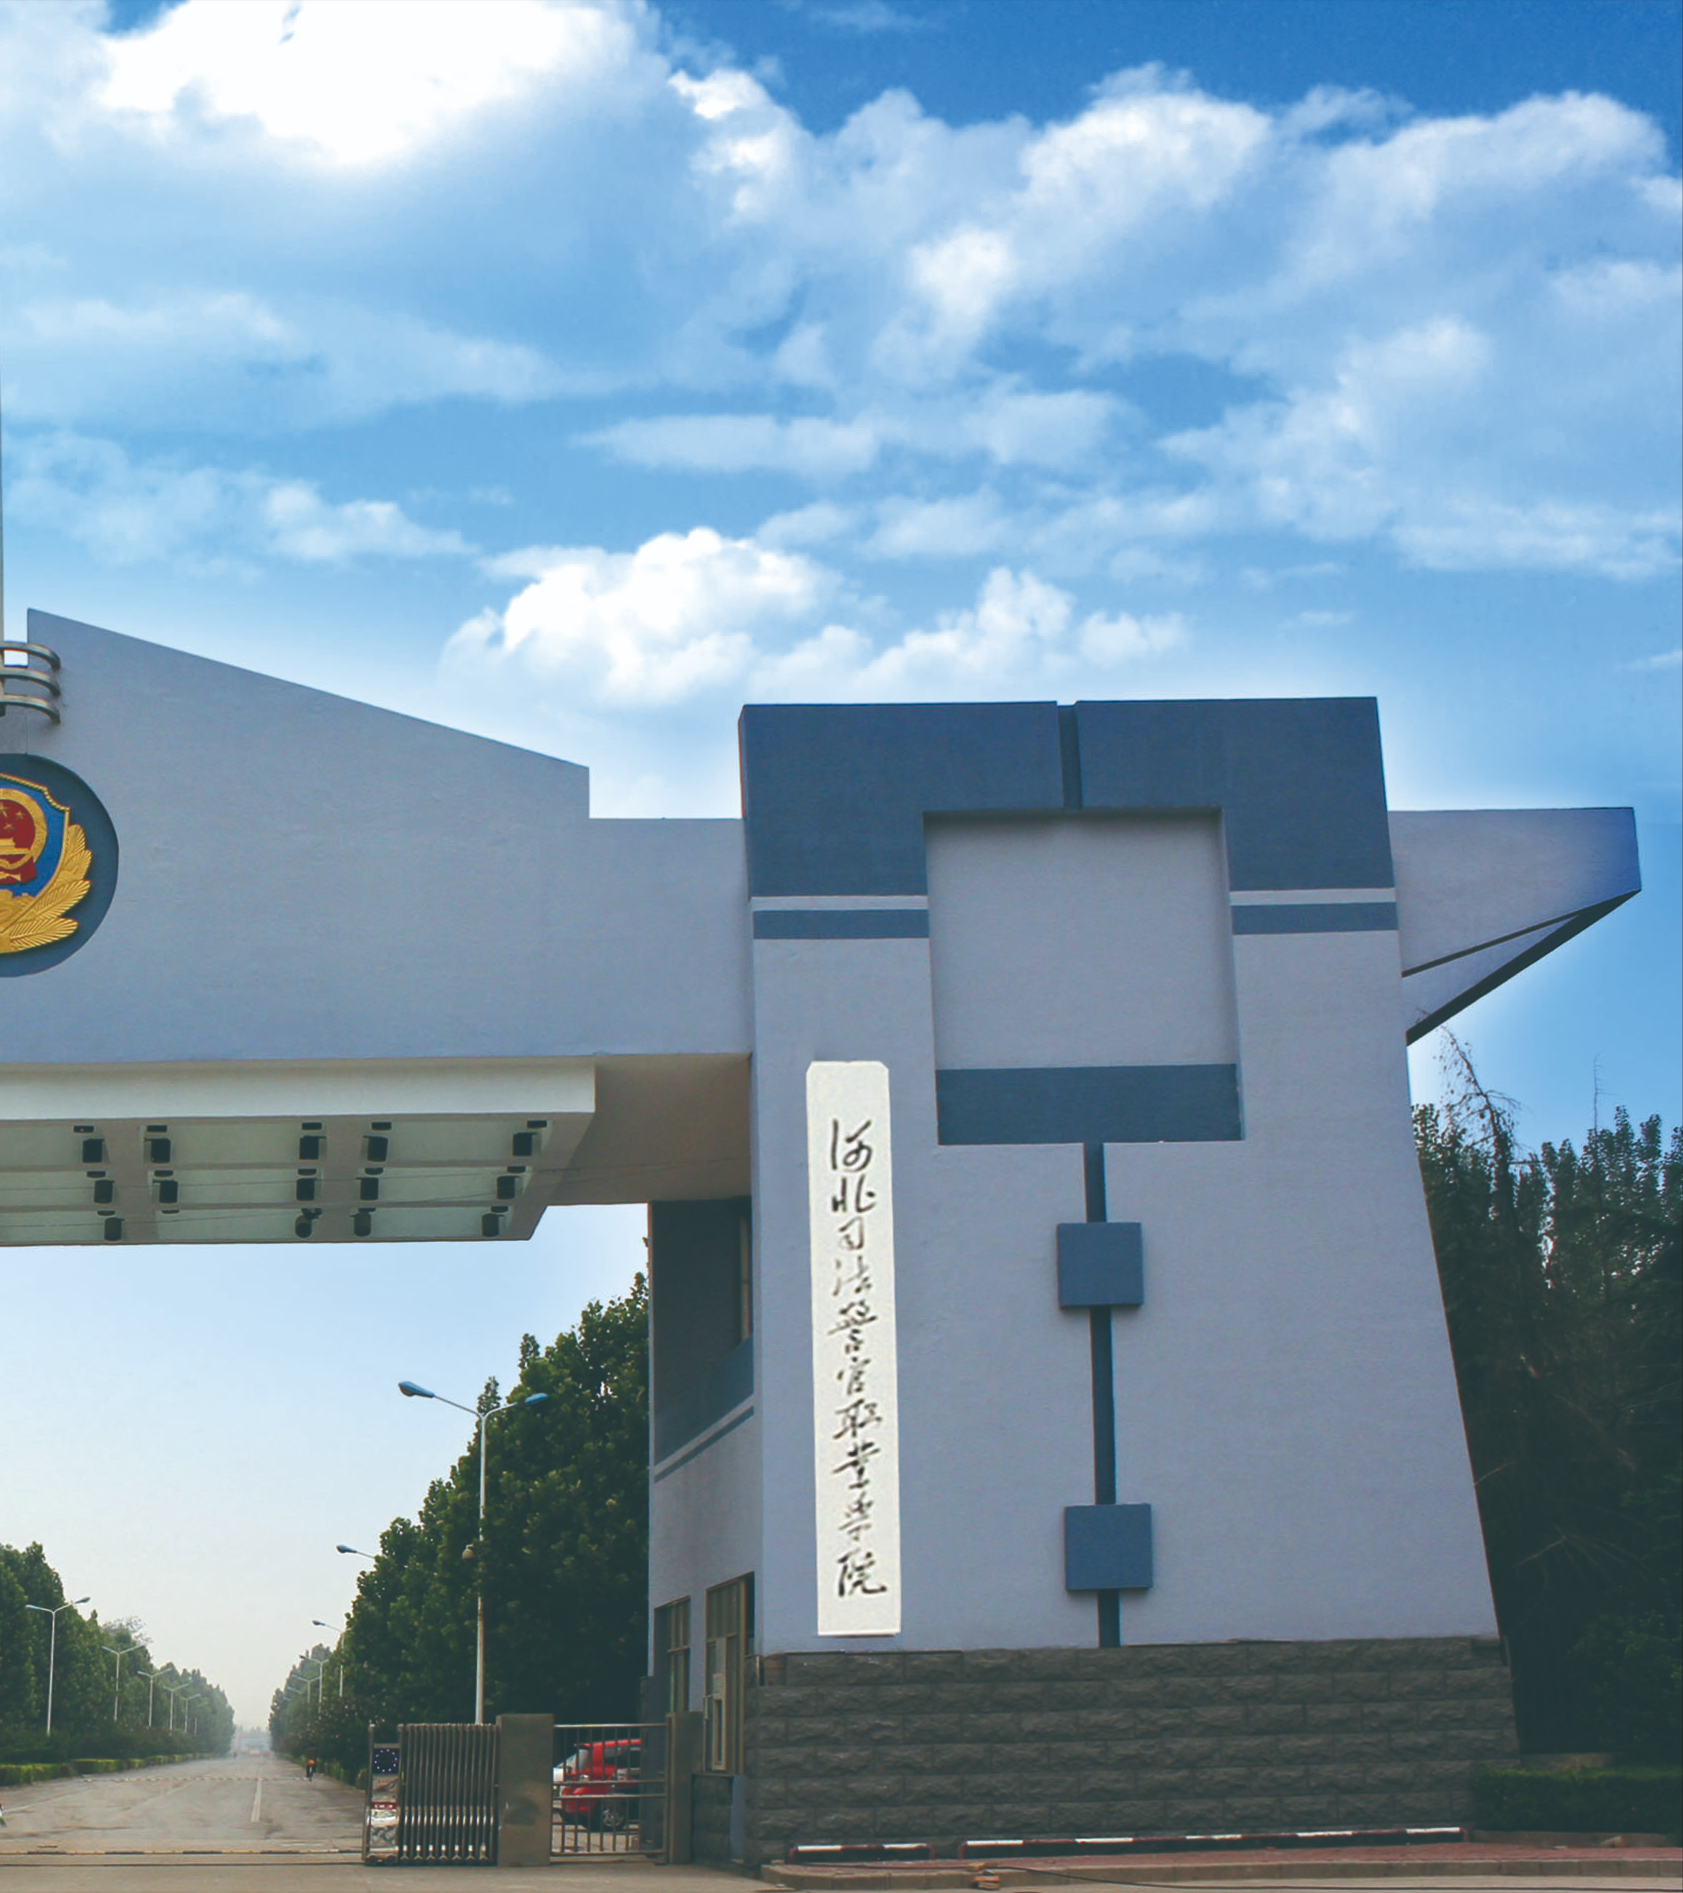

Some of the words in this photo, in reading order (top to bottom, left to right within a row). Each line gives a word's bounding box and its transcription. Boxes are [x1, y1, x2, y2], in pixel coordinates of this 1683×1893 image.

[827, 1118, 887, 1598] 河北司法警官职业学院
